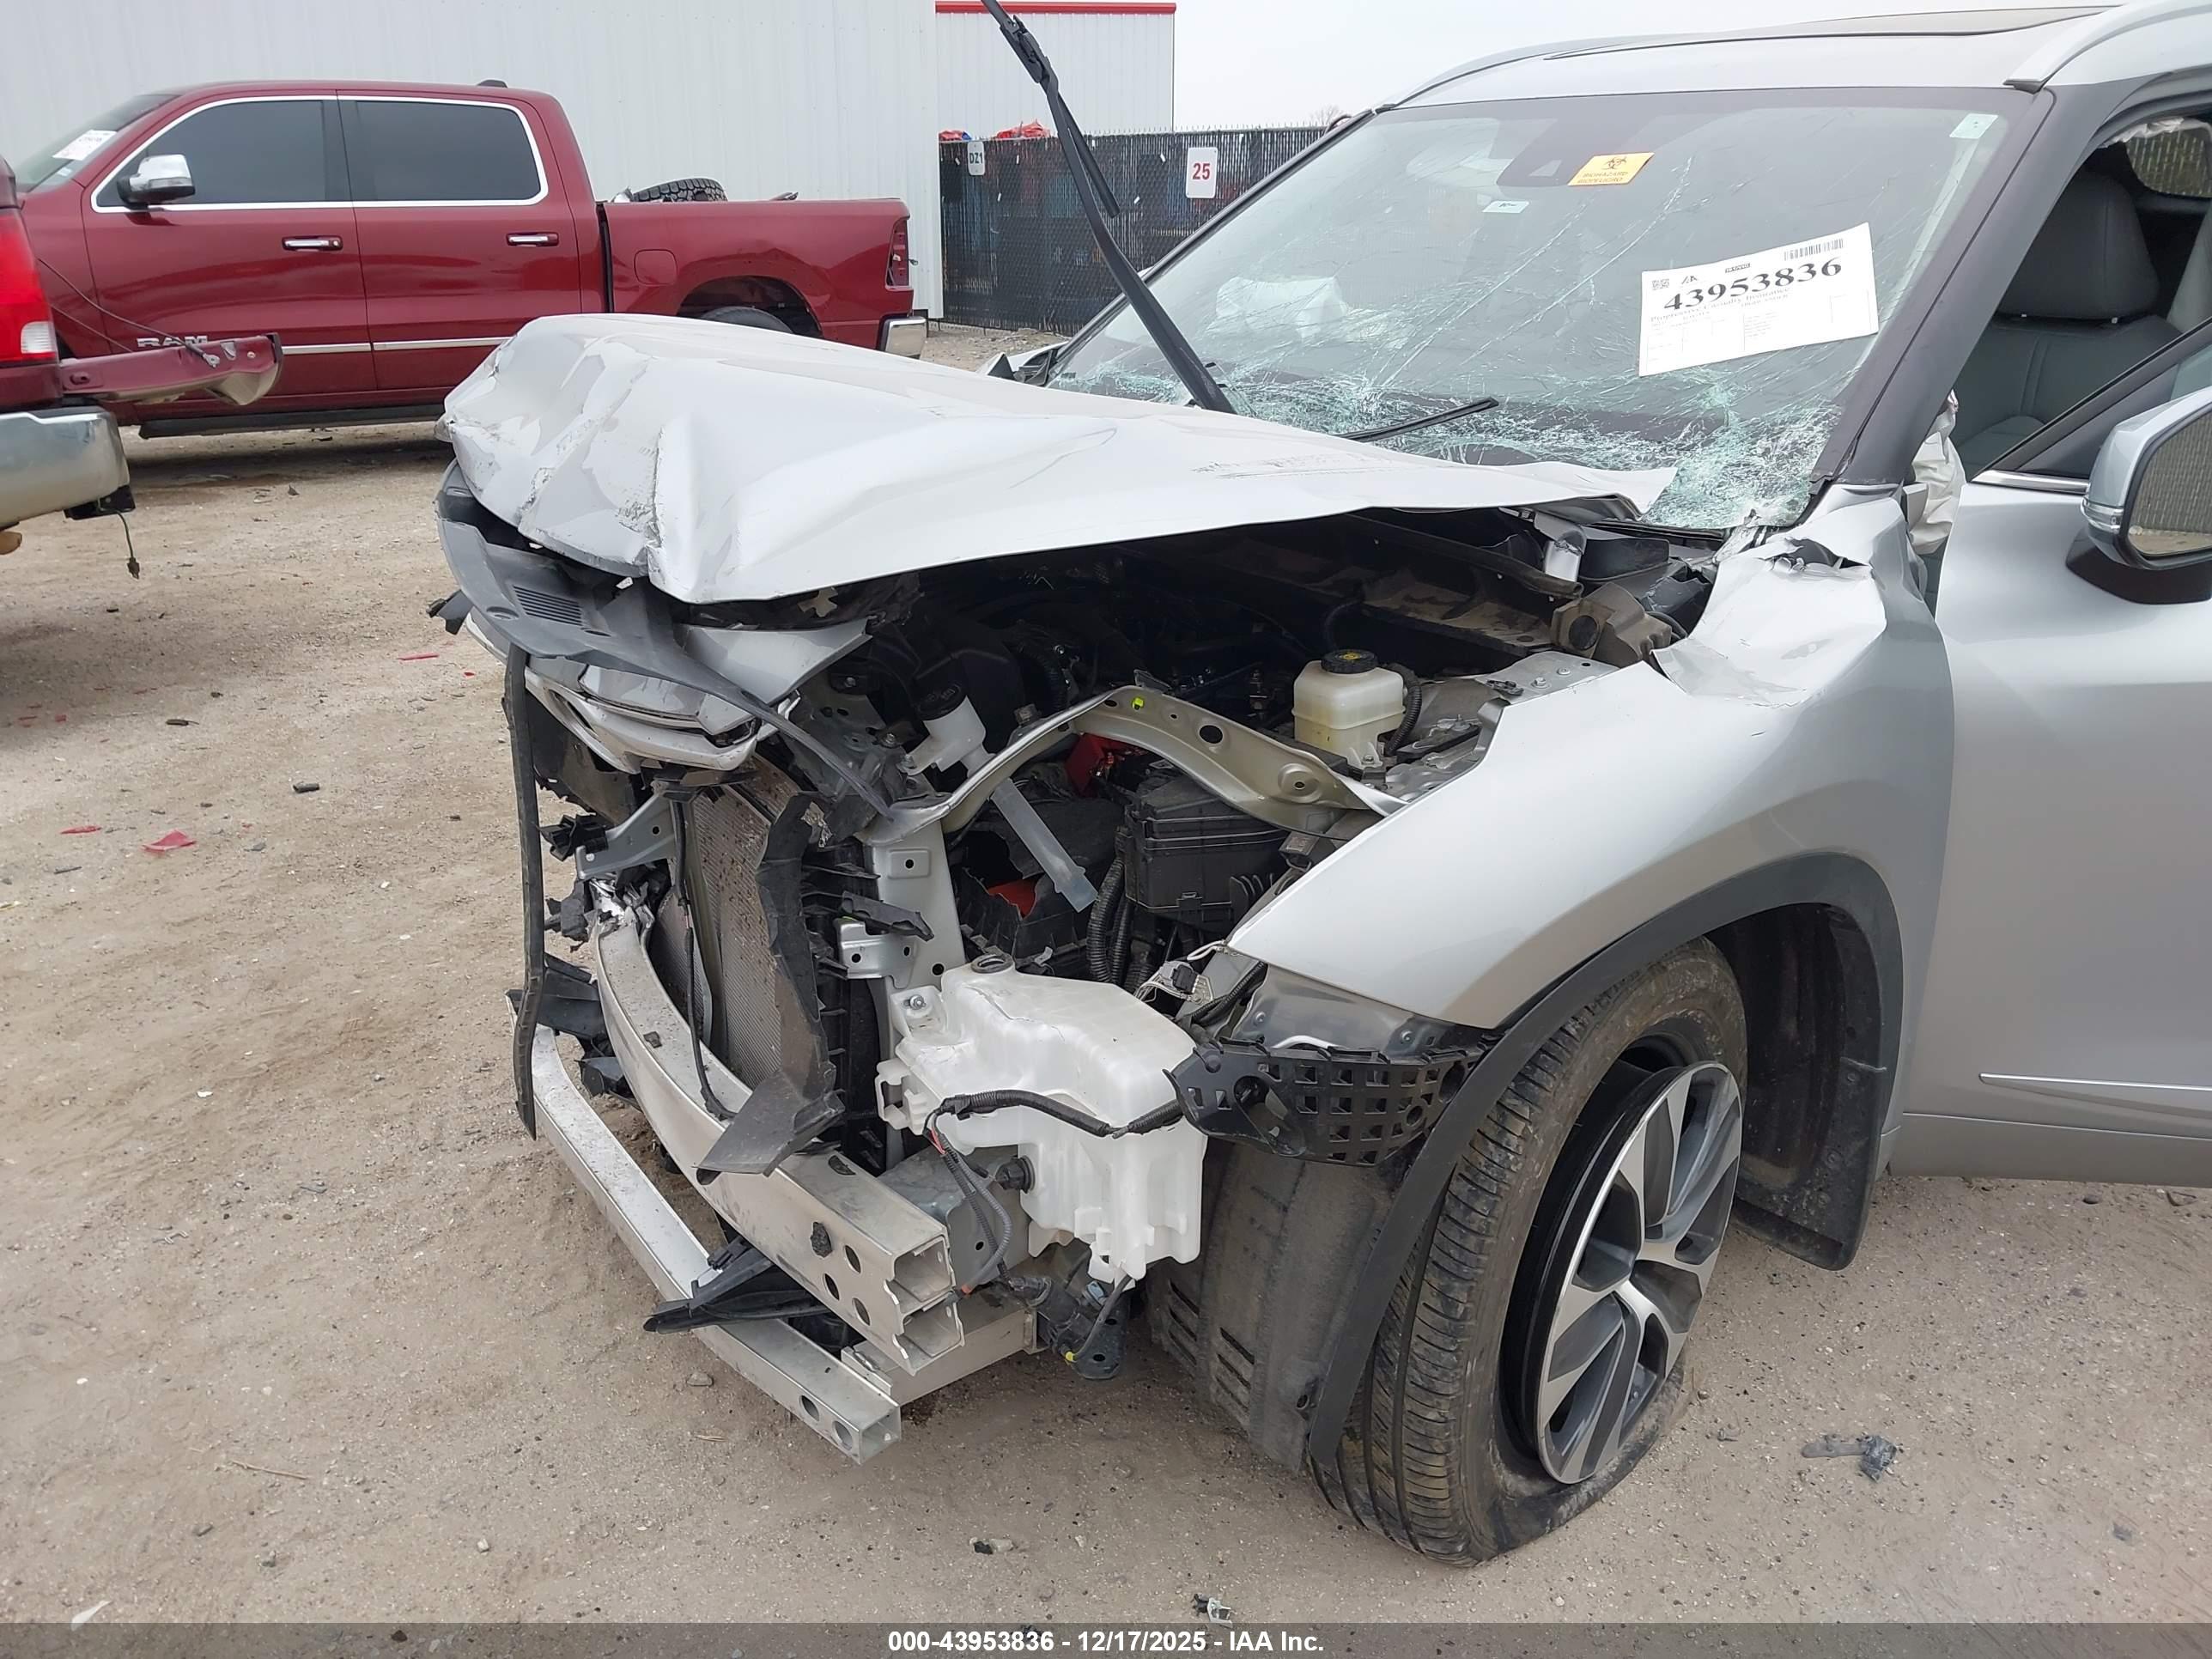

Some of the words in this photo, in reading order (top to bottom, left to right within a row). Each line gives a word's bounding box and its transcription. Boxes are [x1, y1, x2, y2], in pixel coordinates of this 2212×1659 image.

[969, 152, 983, 164] DZ1
[1192, 162, 1211, 180] 25
[1663, 256, 1842, 311] 43953836
[137, 336, 208, 347] RAM
